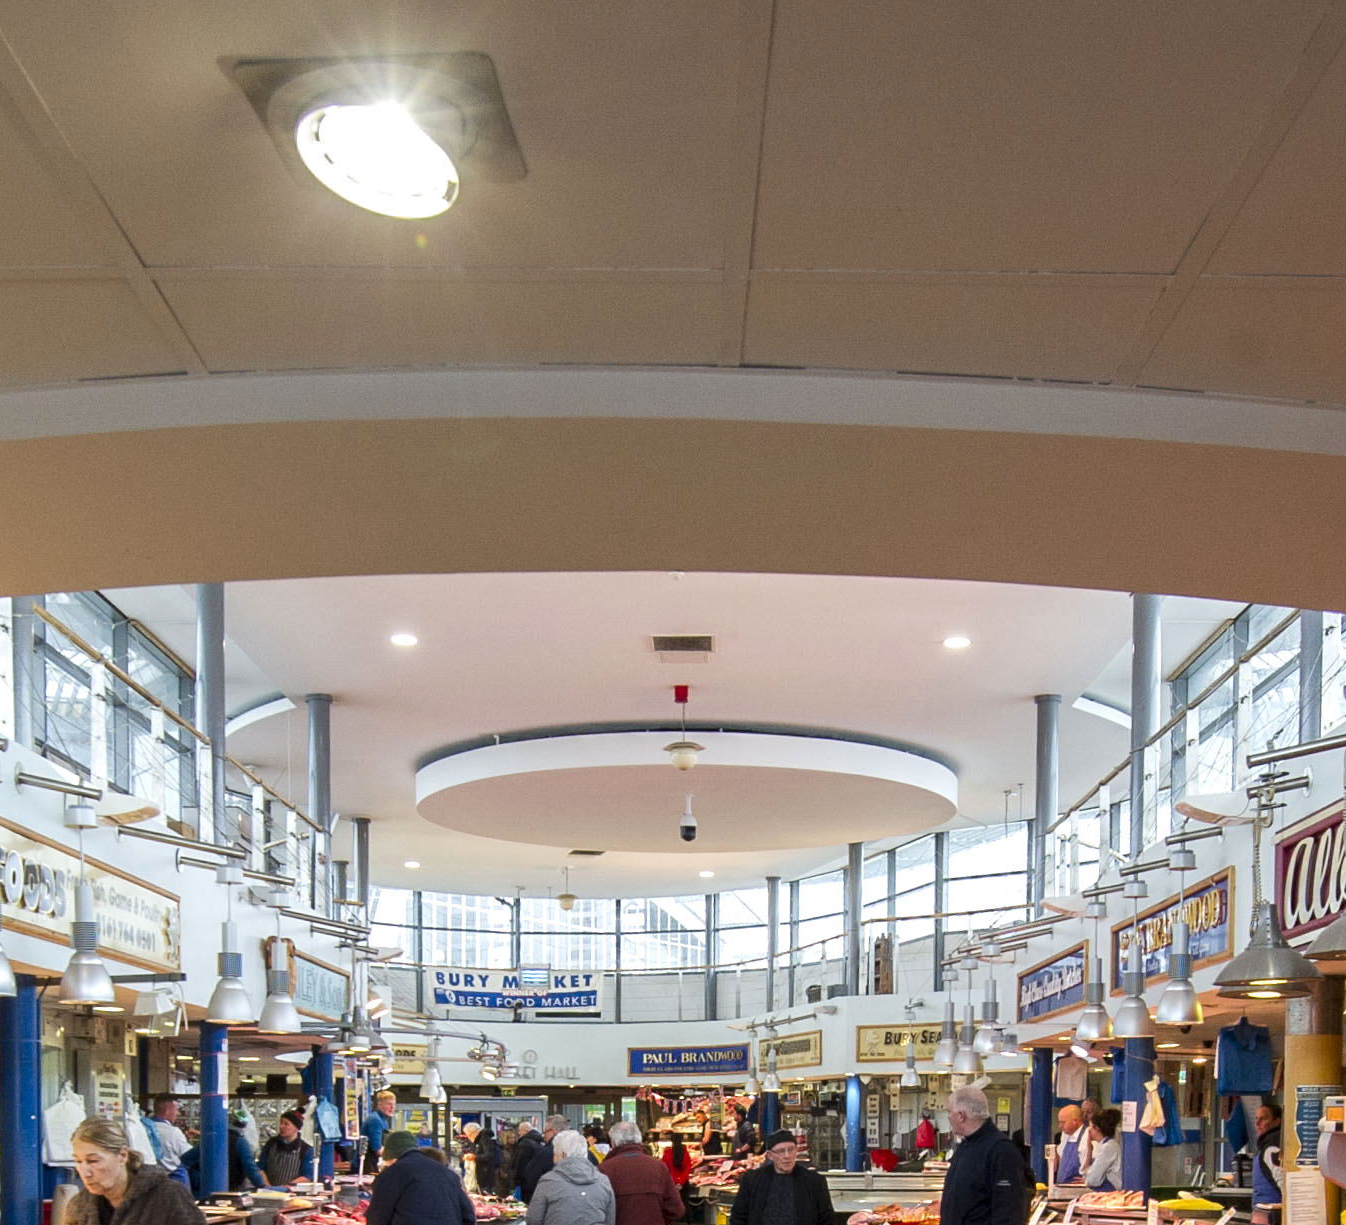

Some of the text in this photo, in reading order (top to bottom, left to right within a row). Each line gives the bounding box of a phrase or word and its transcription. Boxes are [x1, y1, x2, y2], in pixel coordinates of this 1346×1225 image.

[436, 971, 593, 989] BURY MKET
[501, 988, 534, 997] WINNER
[458, 994, 597, 1008] BEST FOOD MARKET
[884, 1030, 915, 1046] BURY
[643, 1050, 743, 1064] PAUL BRANDWOOD
[544, 1066, 581, 1080] HALL
